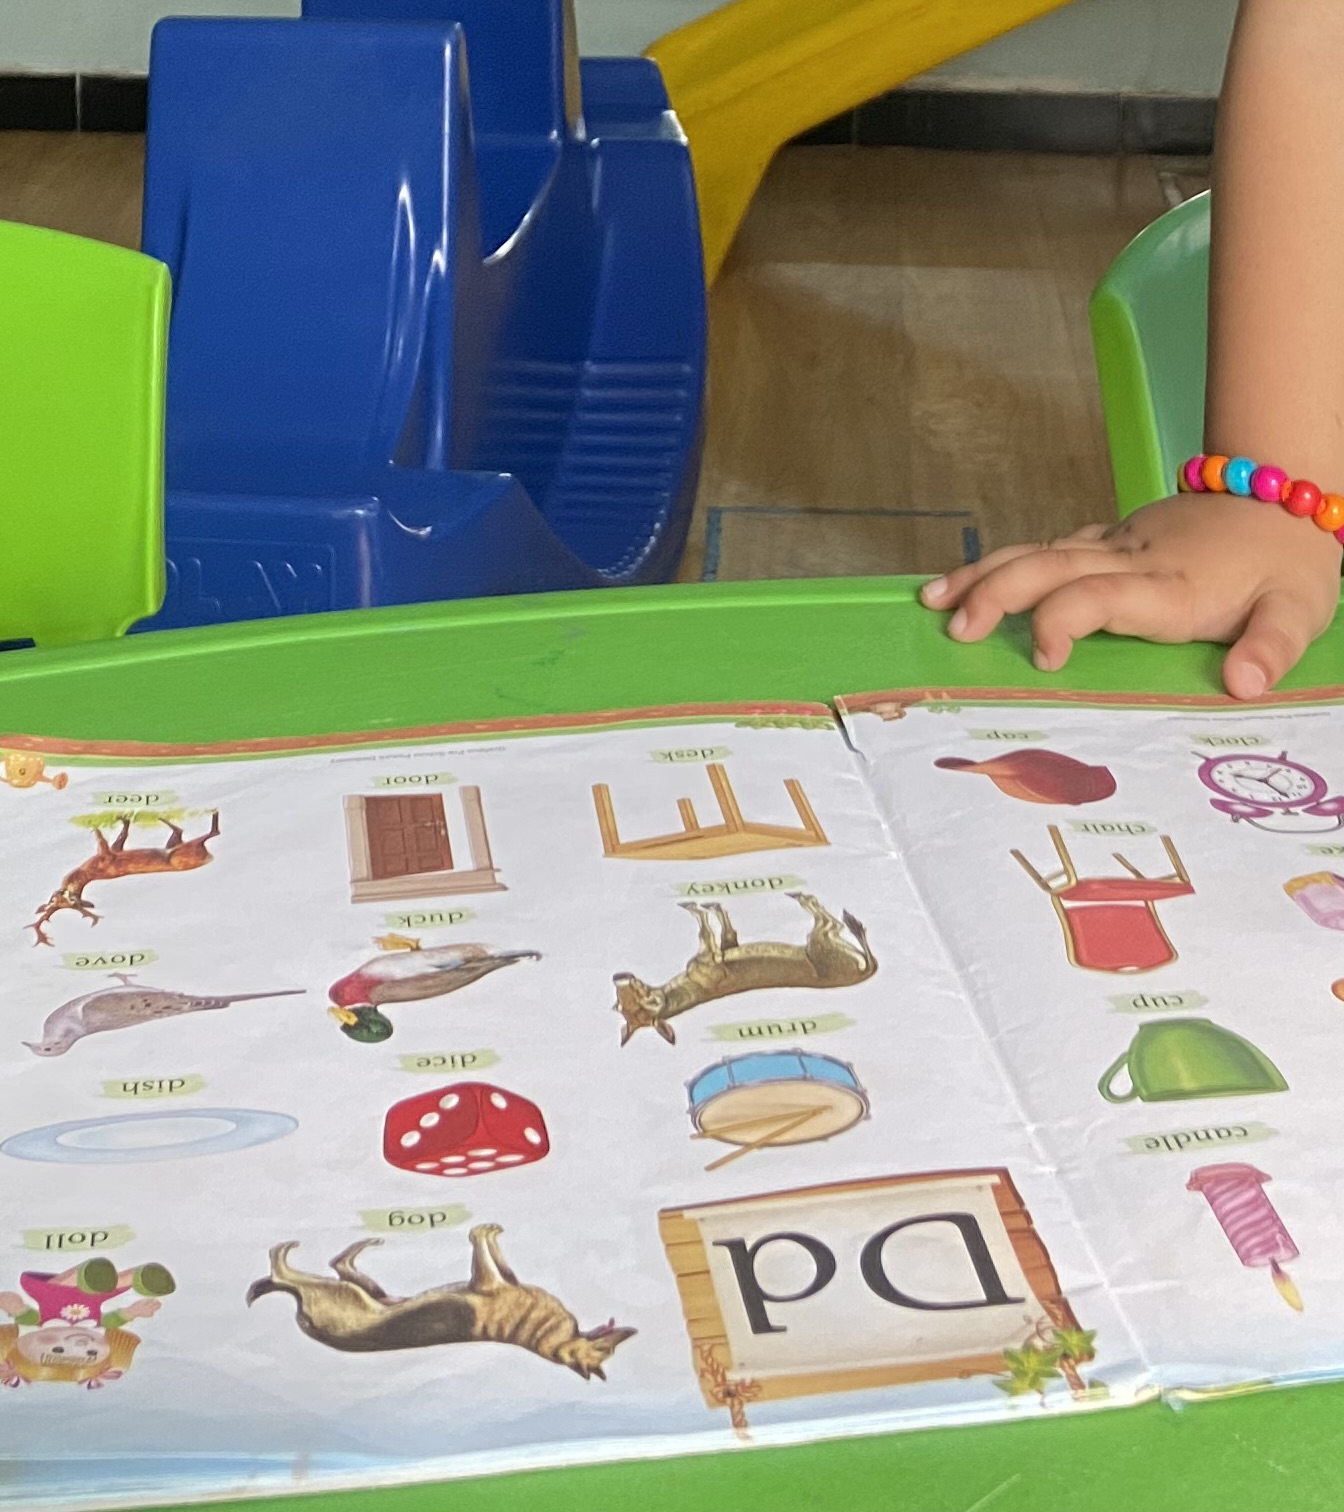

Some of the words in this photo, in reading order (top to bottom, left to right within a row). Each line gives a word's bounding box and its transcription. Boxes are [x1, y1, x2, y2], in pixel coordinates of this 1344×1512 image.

[984, 728, 1032, 741] cap
[1202, 734, 1262, 748] clock
[659, 747, 717, 762] desk
[385, 773, 440, 786] door
[106, 793, 161, 807] deer
[1081, 822, 1147, 837] chair
[685, 875, 785, 898] donkey
[398, 910, 465, 929] duck
[74, 952, 146, 969] dove
[1131, 992, 1185, 1010] cup
[737, 1019, 818, 1039] drum
[415, 1053, 478, 1070] dice
[121, 1078, 187, 1096] dish
[1144, 1125, 1249, 1153] candle
[387, 1210, 448, 1229] dog
[44, 1230, 110, 1251] doll
[712, 1212, 1027, 1335] Dd
